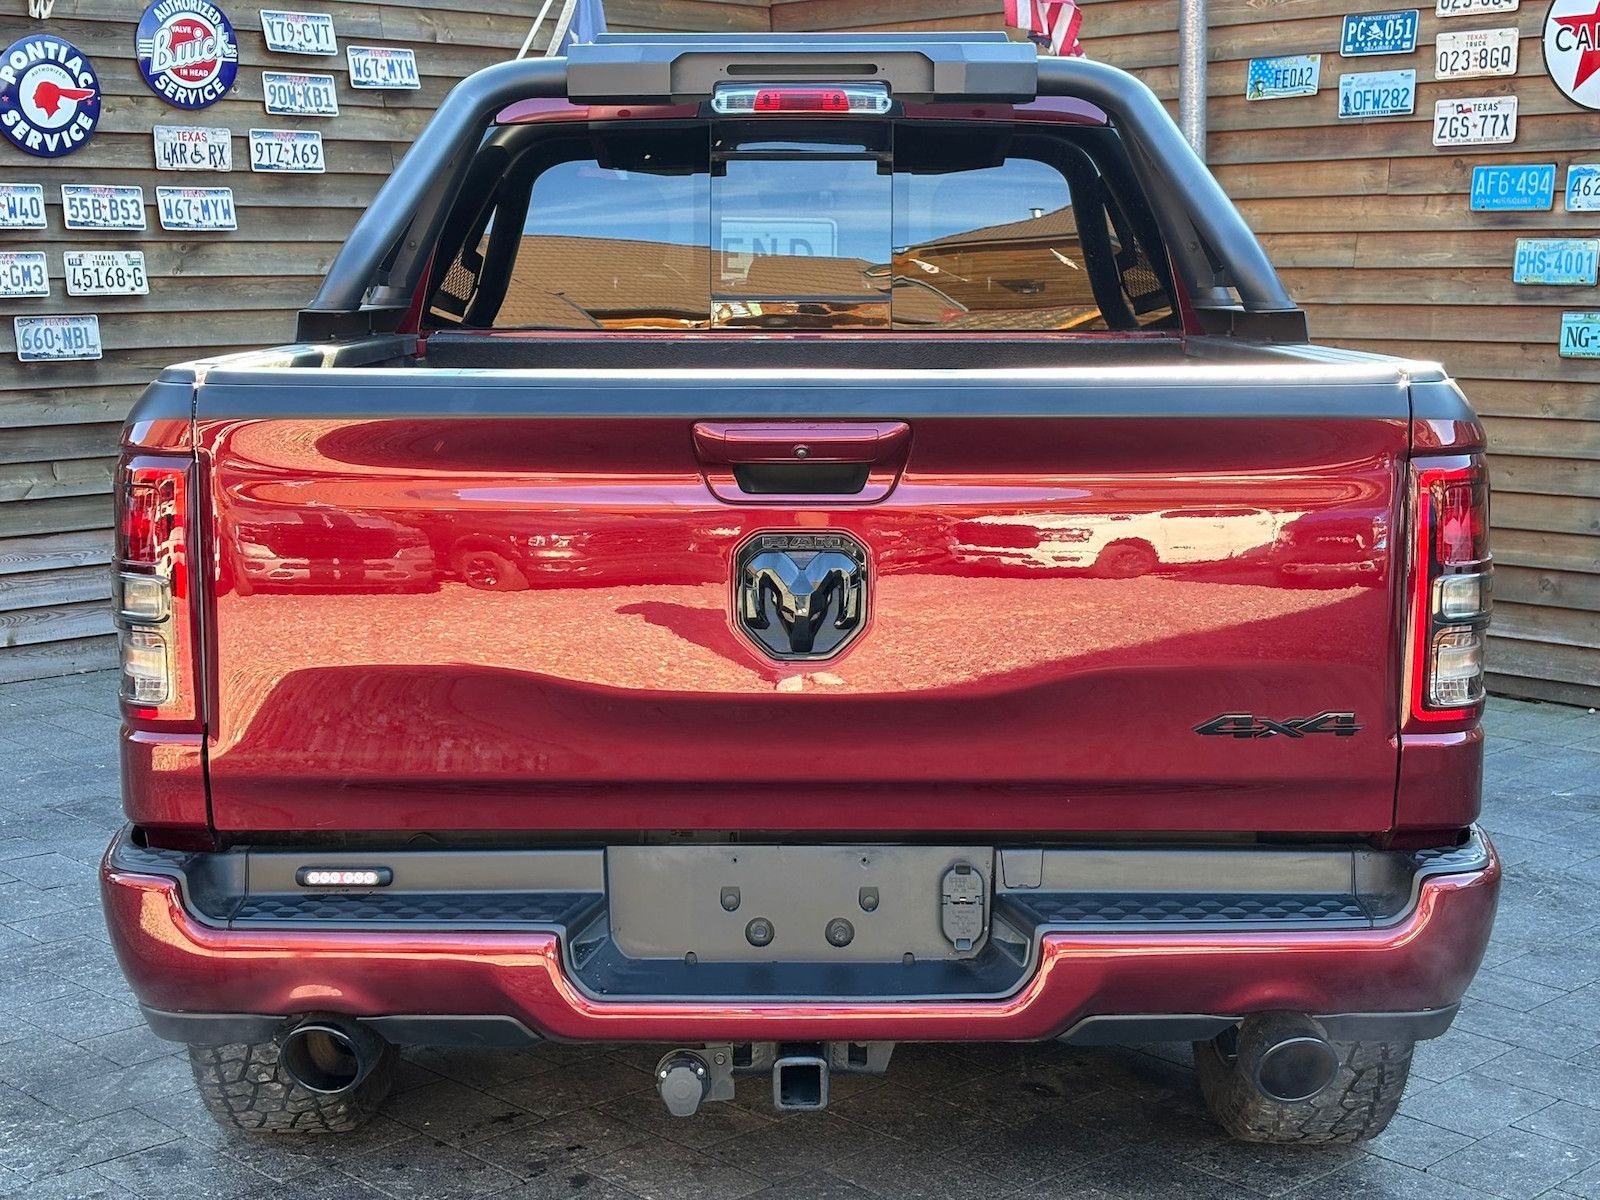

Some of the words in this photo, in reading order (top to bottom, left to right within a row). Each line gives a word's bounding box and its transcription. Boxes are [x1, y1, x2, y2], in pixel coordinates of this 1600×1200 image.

[153, 0, 220, 25] AUTHORIZED
[1347, 21, 1367, 42] PC
[1466, 33, 1488, 41] TEXAS
[1555, 25, 1600, 52] CA
[149, 23, 238, 75] Buick
[0, 41, 94, 88] PONTIAC
[31, 66, 66, 79] AUTHORIZED
[190, 69, 208, 77] HEAD
[155, 75, 225, 105] SERVICE
[1473, 102, 1499, 112] TEXAS
[1, 110, 94, 152] SERVICE
[177, 131, 207, 142] TEXAS
[208, 144, 226, 165] RX
[1565, 326, 1600, 348] NG-
[761, 536, 842, 548] RAM
